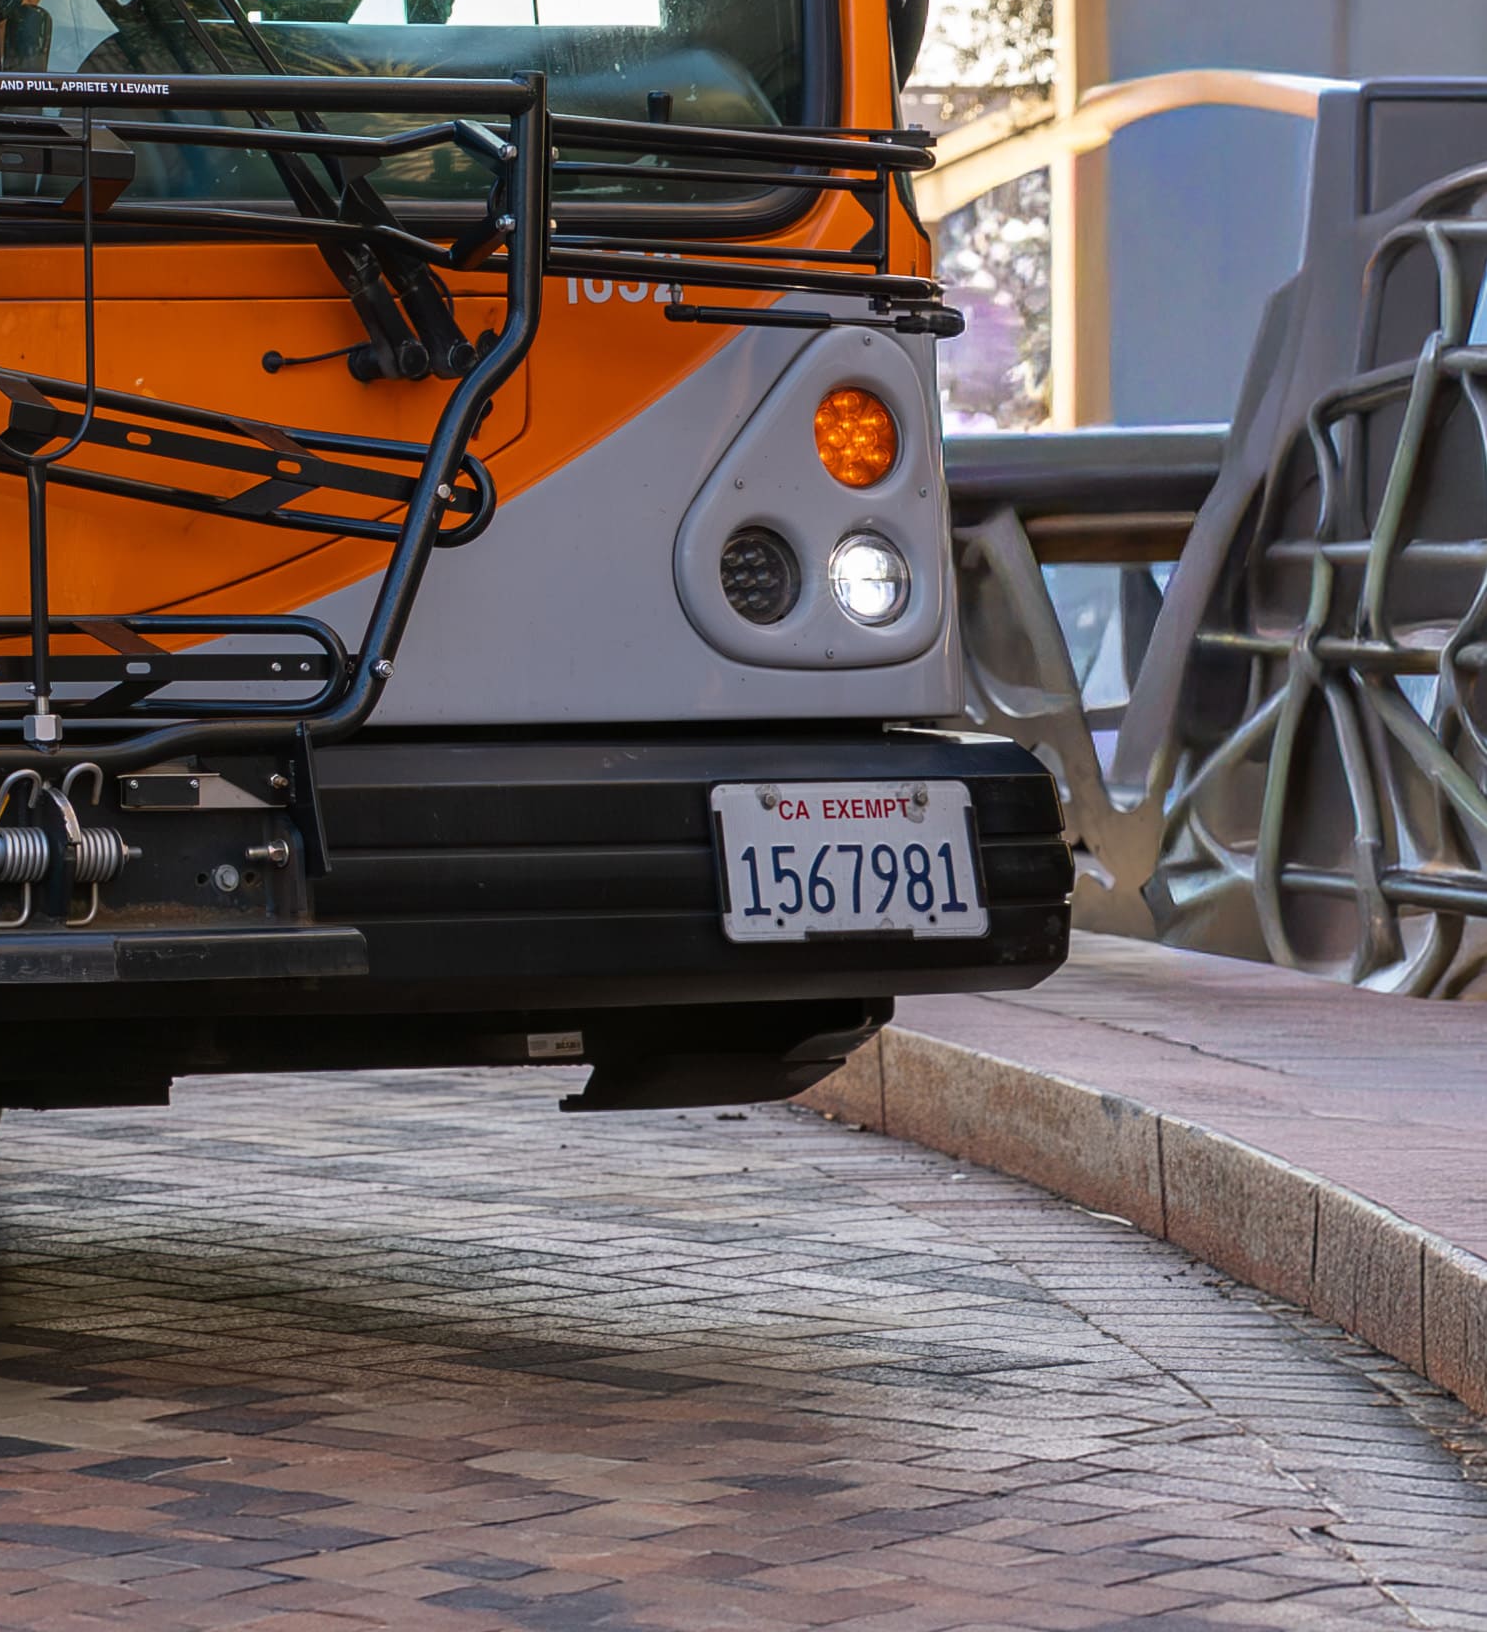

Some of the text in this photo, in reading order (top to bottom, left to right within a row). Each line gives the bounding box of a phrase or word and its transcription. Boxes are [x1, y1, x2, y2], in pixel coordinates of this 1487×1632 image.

[0, 80, 24, 90] AND
[26, 81, 59, 92] PULL,
[61, 81, 108, 92] APRIETE
[110, 82, 119, 93] Y
[120, 83, 169, 94] LEVANTE
[778, 798, 911, 821] CA EXEMPT
[740, 842, 968, 917] 1567981
